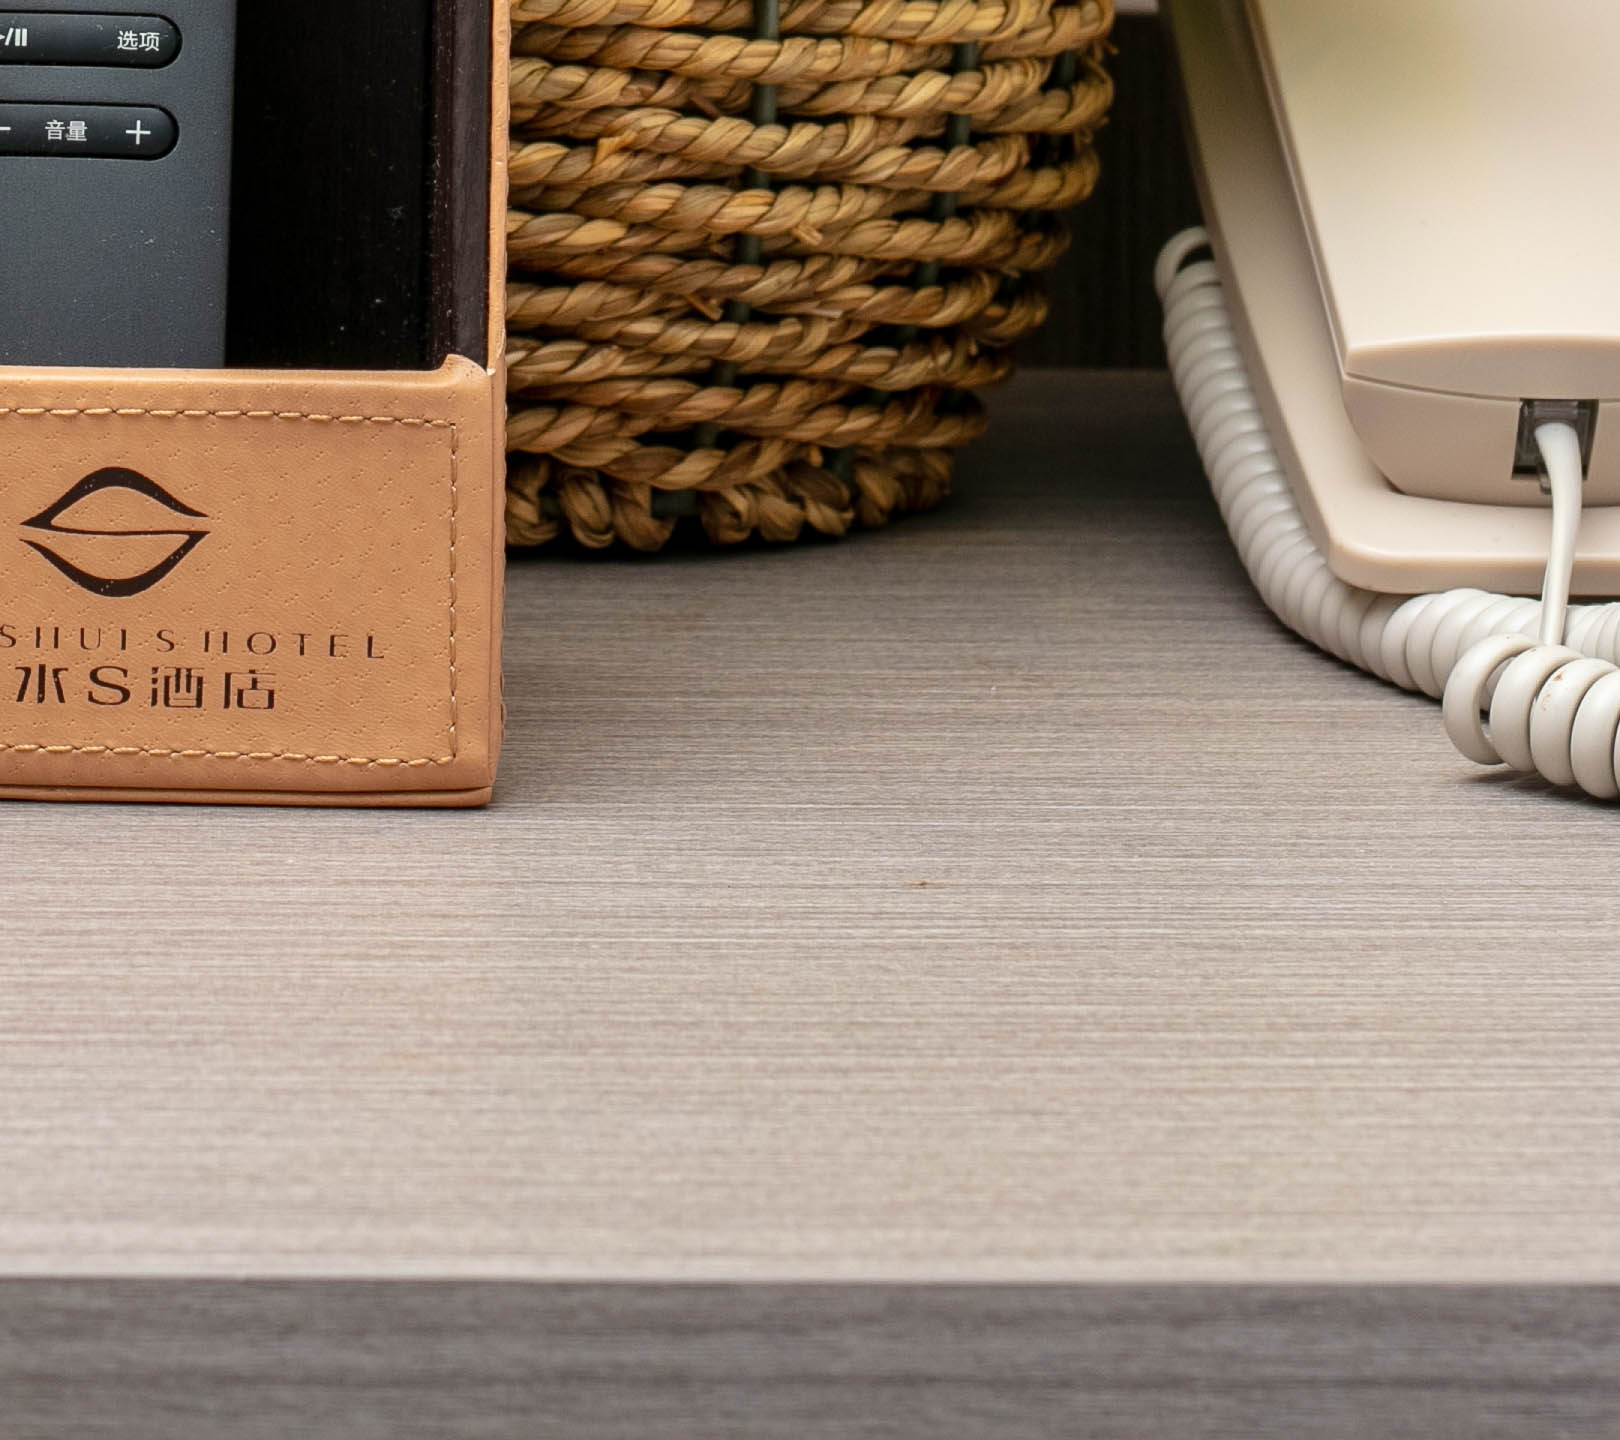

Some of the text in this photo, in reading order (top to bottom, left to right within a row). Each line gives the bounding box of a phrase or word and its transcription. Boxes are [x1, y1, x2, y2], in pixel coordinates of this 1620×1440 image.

[117, 30, 160, 52] 选项
[44, 119, 88, 142] 音量
[156, 629, 175, 653] S
[203, 630, 385, 659] HOTEL
